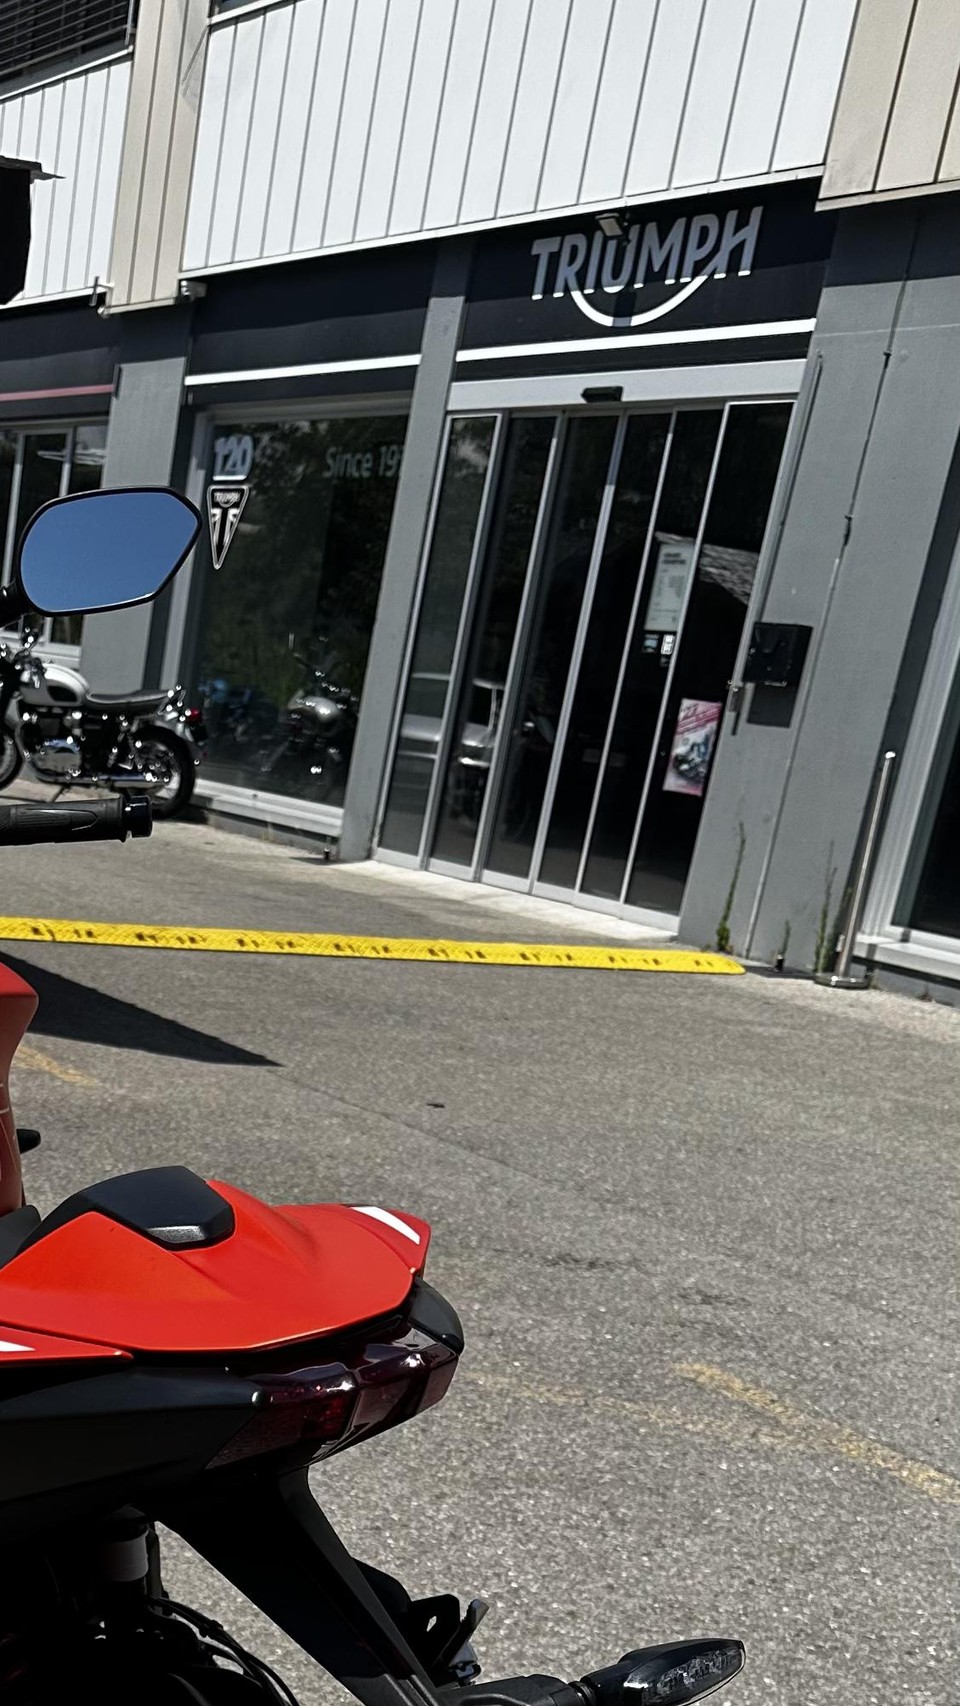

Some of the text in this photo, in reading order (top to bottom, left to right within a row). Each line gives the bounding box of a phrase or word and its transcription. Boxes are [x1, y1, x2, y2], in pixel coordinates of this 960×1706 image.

[531, 206, 764, 327] TRIUMPH
[213, 434, 254, 481] 120
[322, 446, 374, 479] Since
